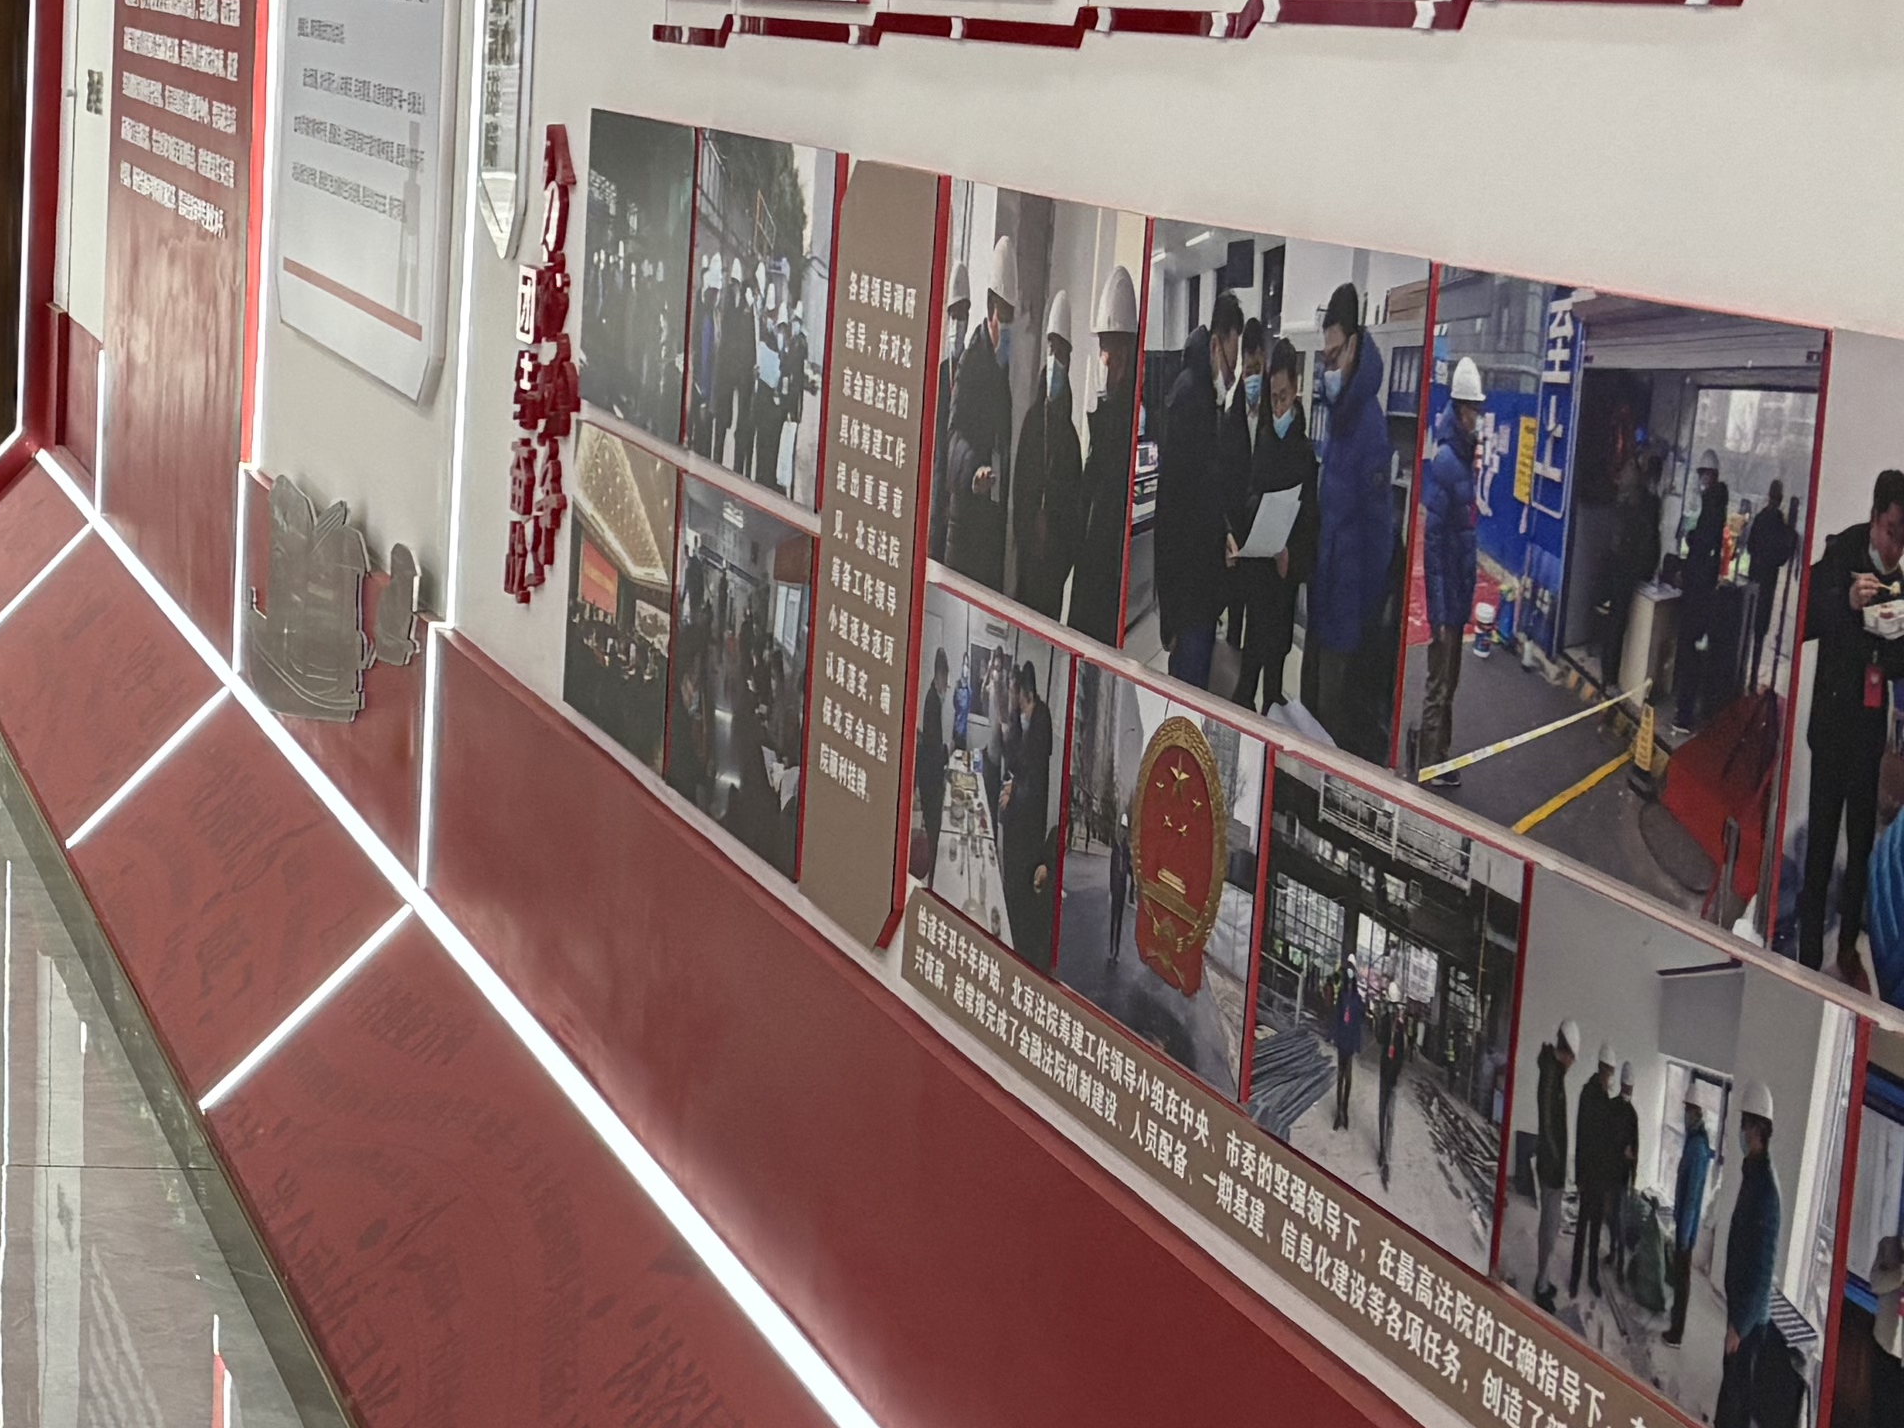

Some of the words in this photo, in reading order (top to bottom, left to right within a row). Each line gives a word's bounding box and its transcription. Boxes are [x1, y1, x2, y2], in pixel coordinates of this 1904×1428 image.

[847, 270, 916, 319] 各级领导调研
[841, 366, 909, 419] 京金融法院的
